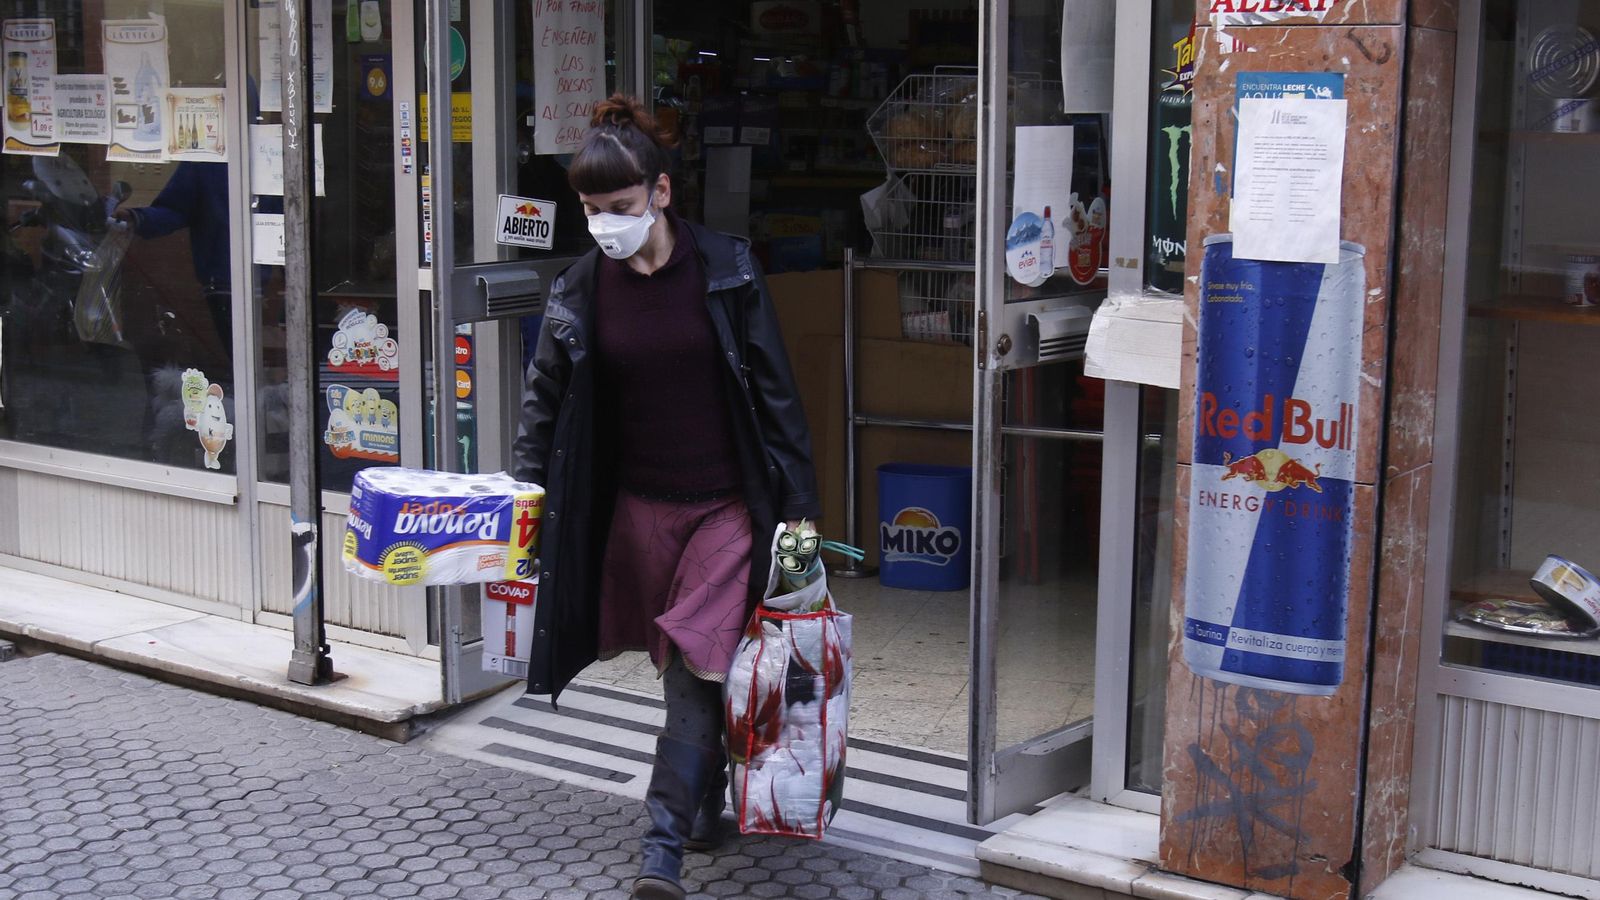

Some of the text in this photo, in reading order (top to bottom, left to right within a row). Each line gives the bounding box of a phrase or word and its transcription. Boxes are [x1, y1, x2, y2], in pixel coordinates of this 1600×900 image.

[541, 26, 597, 47] ENSEÑEN
[561, 54, 584, 72] LAS
[557, 77, 594, 95] BOLSAS
[1242, 83, 1306, 91] ENCUENTRA LECHE
[542, 103, 559, 120] AL
[503, 216, 549, 239] ABIERTO
[1018, 256, 1036, 270] evian
[1199, 391, 1354, 451] Red Bull
[1199, 490, 1343, 521] ENERGY DRINK
[393, 511, 499, 541] Renova
[516, 510, 541, 549] 4
[881, 523, 961, 556] MIKO
[489, 583, 530, 599] COVAP
[1231, 631, 1283, 651] Revitaliza
[1285, 641, 1318, 657] cuerpo
